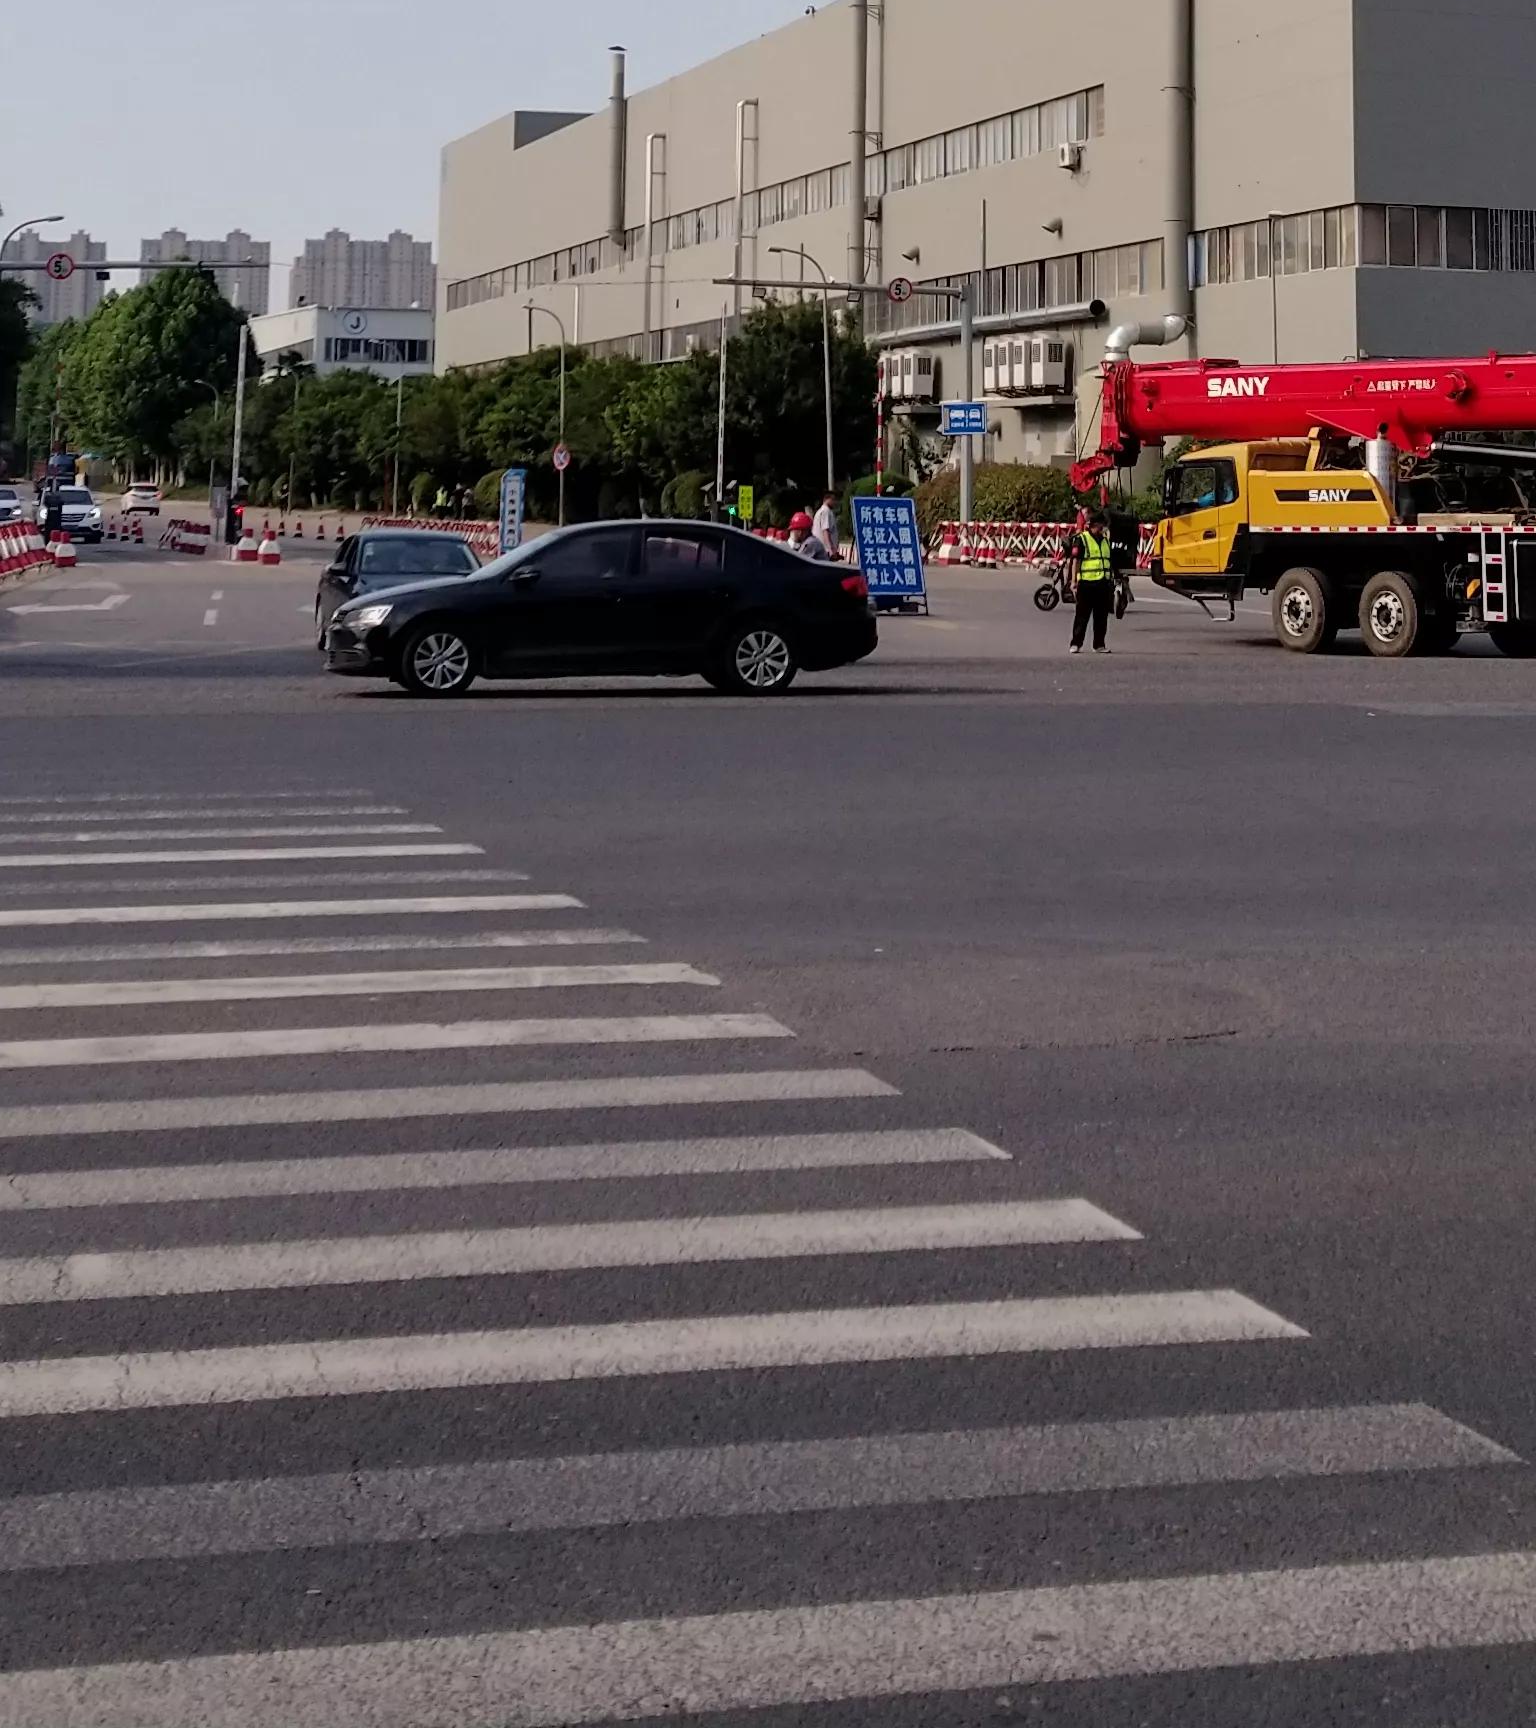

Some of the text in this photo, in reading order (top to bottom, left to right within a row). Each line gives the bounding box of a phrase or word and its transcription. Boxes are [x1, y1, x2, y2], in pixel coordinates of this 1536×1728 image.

[350, 316, 360, 329] J
[1207, 377, 1269, 397] SANY
[1308, 489, 1350, 502] SANY
[860, 506, 910, 524] 所有车辆
[862, 526, 912, 544] 凭证入园
[864, 547, 914, 565] 无证车辆
[866, 567, 917, 586] 禁止入园
